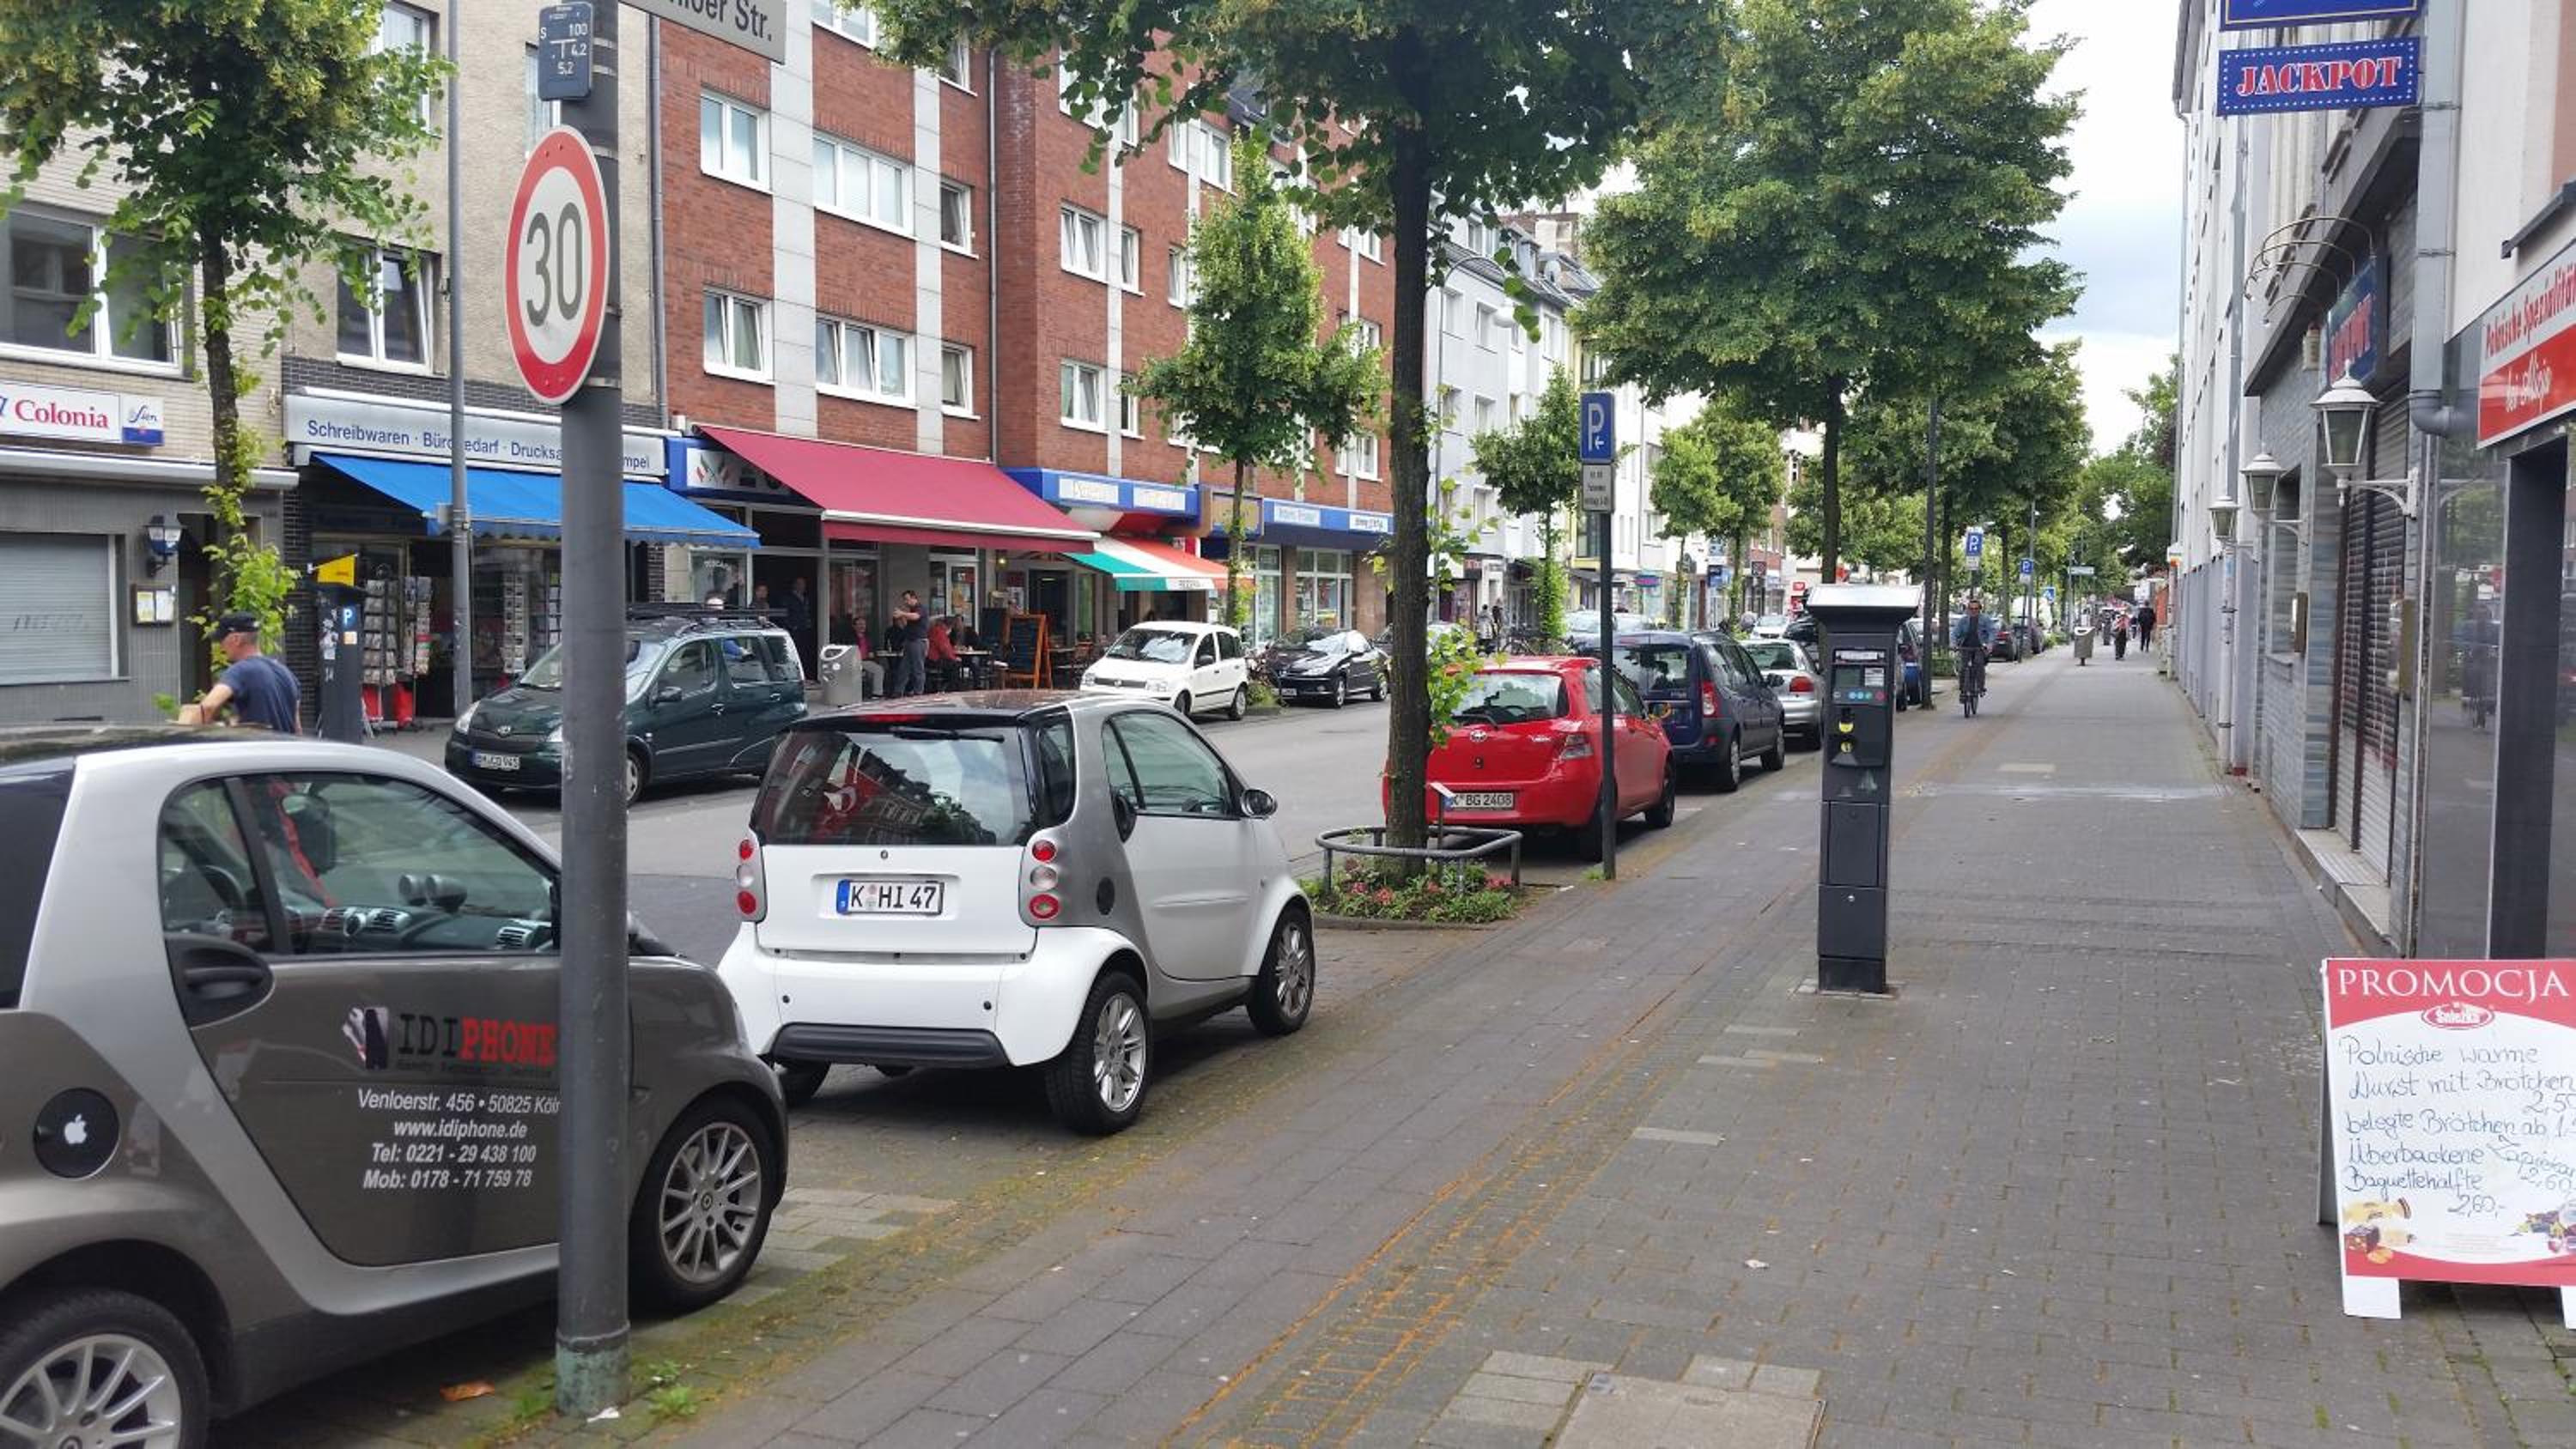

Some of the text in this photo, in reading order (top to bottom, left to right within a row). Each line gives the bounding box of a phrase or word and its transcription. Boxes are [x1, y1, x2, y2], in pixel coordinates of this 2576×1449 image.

[735, 0, 771, 41] Str.
[2235, 56, 2403, 97] JACKPOT
[526, 202, 583, 327] 30
[15, 398, 109, 429] Colonia
[1588, 403, 1605, 452] P
[308, 420, 650, 471] Schreibwaren Büroedarf Drucksa mpel
[1466, 794, 1481, 806] BG
[851, 885, 937, 909] K HI 47
[2338, 968, 2569, 1003] PROMOCJA
[398, 1013, 556, 1067] IDIPHONE
[2428, 1070, 2470, 1094] mit
[358, 1088, 440, 1111] Venloerstr.
[446, 1093, 475, 1113] 456
[488, 1094, 532, 1113] 50825
[393, 1119, 529, 1142] www.idiphone.de
[372, 1143, 402, 1162] Tel:
[406, 1144, 445, 1163] 0221
[458, 1144, 478, 1163] 29
[480, 1144, 508, 1163] 438
[512, 1144, 538, 1163] 100
[363, 1168, 407, 1189] Mob:
[410, 1169, 450, 1189] 0178
[462, 1169, 481, 1188] 71
[485, 1169, 512, 1188] 759
[514, 1169, 533, 1188] 78
